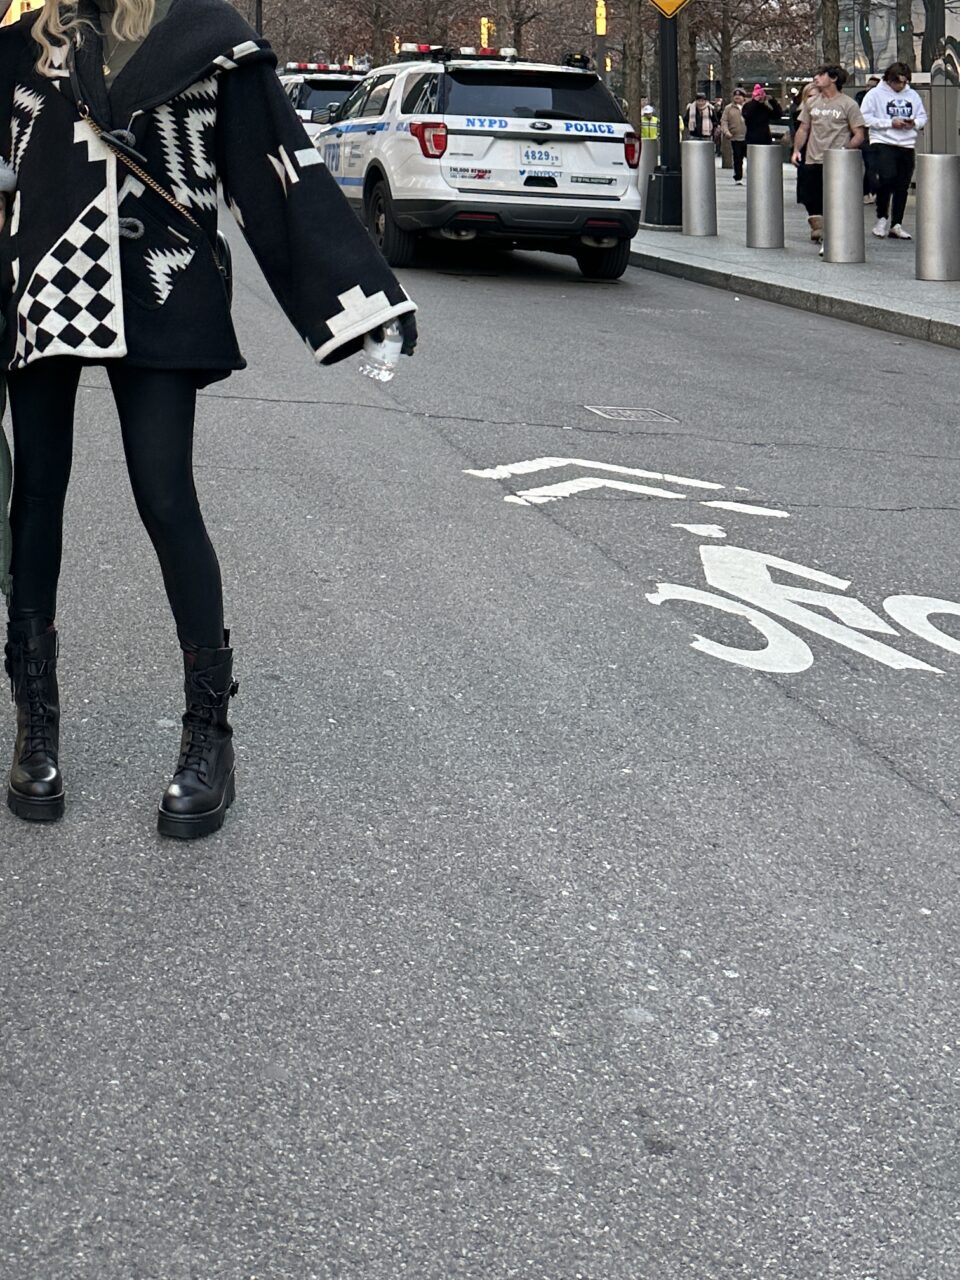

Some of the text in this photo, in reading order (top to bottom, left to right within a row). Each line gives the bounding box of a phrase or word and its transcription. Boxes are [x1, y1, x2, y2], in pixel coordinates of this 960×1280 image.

[466, 118, 508, 129] NYPD
[564, 122, 615, 134] POLICE
[524, 150, 550, 161] 4829
